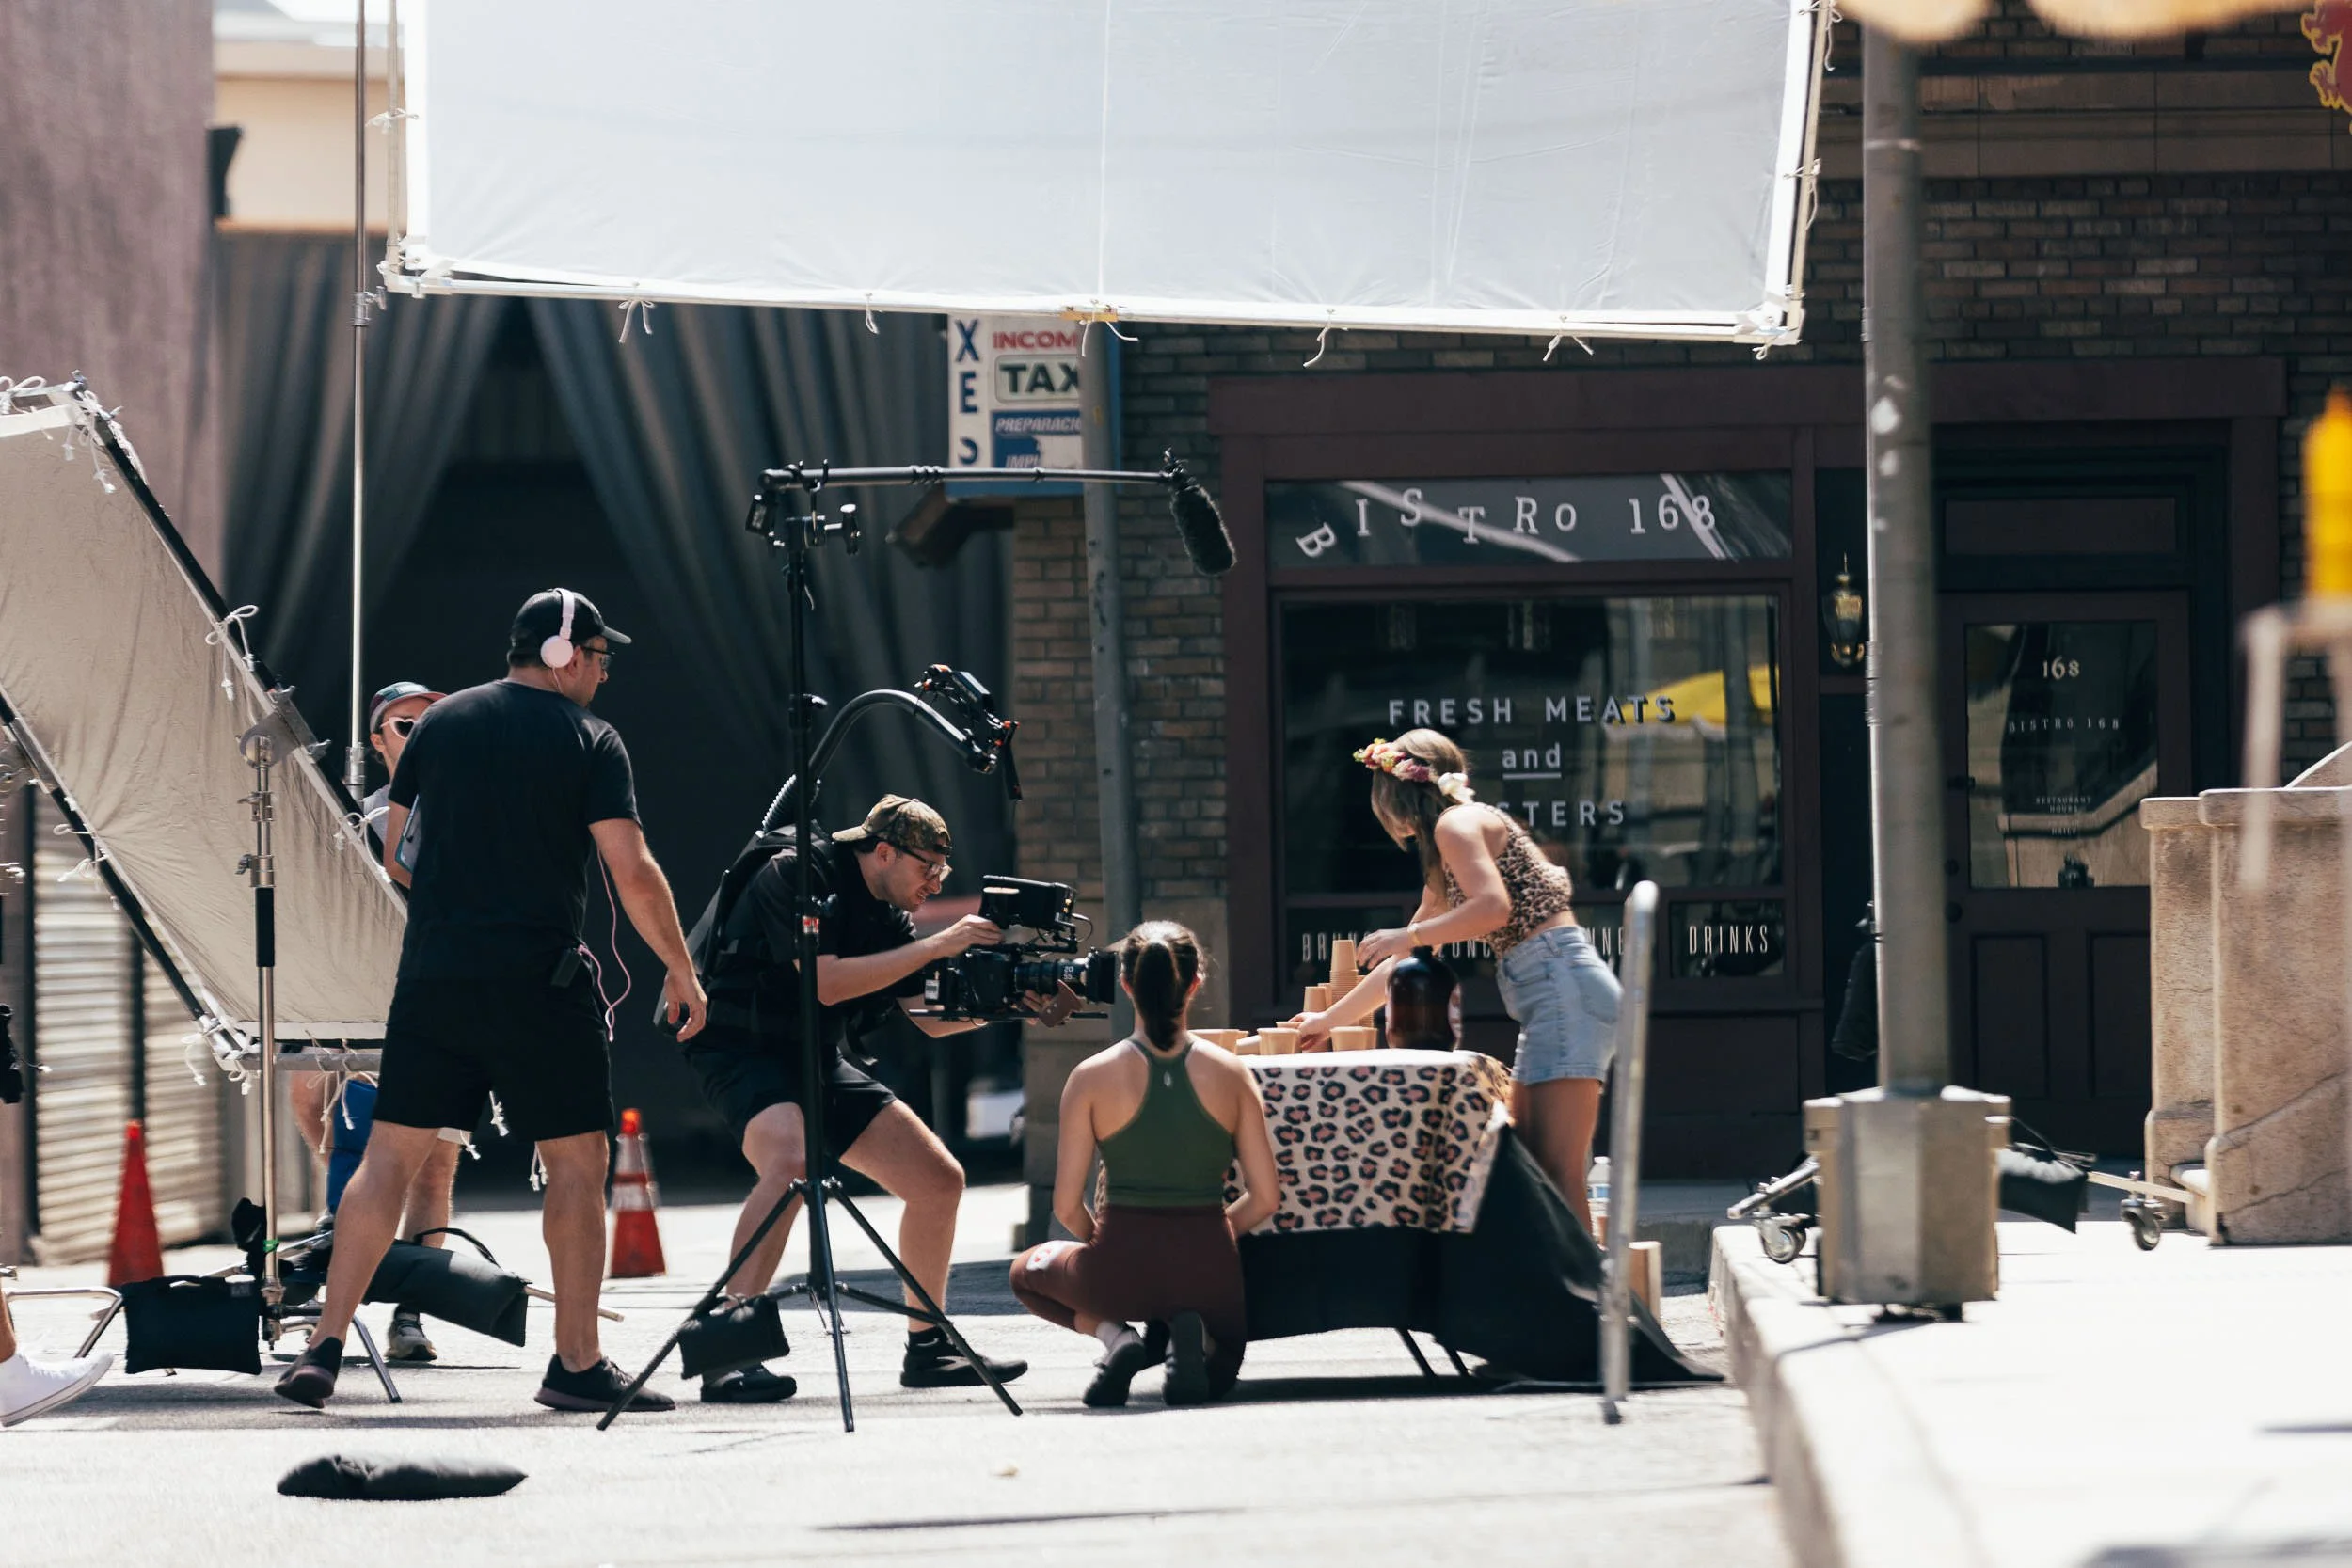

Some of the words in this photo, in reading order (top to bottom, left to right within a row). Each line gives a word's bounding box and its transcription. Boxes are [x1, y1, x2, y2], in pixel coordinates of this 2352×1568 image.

[999, 363, 1079, 393] TAX
[1629, 493, 1715, 534] 168
[2042, 657, 2080, 679] 168
[1389, 698, 1511, 725] FRESH
[1545, 695, 1674, 723] MEATS
[1502, 742, 1561, 768] and
[1497, 801, 1624, 827] TERS
[1689, 925, 1768, 954] DRINKS
